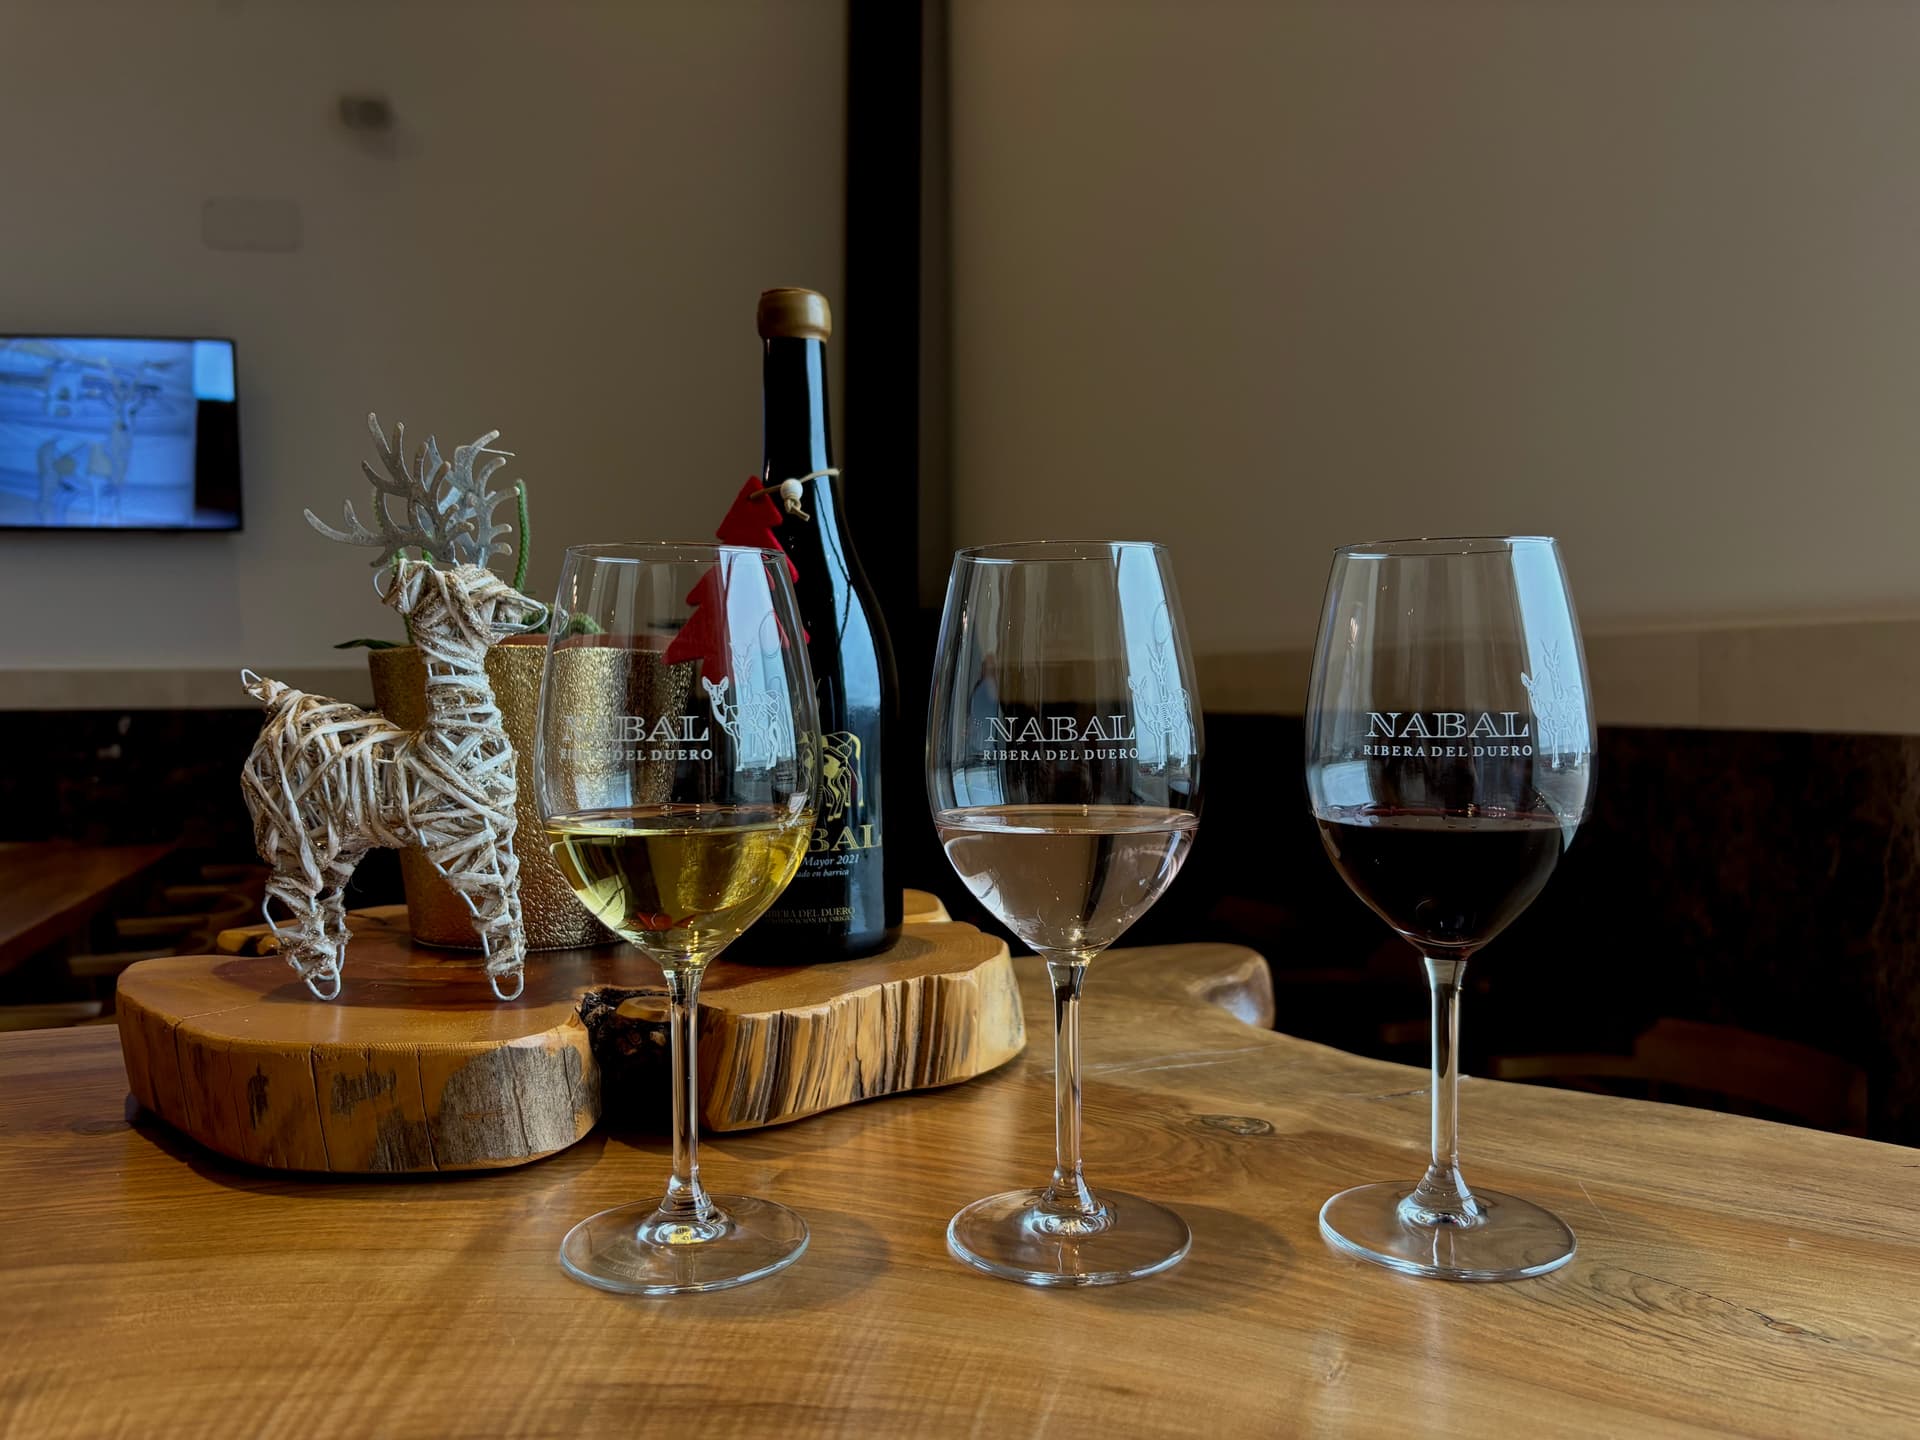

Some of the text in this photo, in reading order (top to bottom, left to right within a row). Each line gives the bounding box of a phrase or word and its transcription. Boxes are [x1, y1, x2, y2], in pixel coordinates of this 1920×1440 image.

[983, 715, 1136, 742] NABAL
[1365, 711, 1530, 738] NABAL
[613, 749, 646, 761] DEL
[650, 748, 713, 761] DUERO
[983, 747, 1139, 761] RIBERA DEL DUERO
[1363, 744, 1533, 757] RIBERA DEL DUERO
[808, 824, 883, 853] BAL
[802, 853, 860, 869] Mayor 2021
[823, 867, 850, 878] barrica
[821, 906, 856, 918] DUERO
